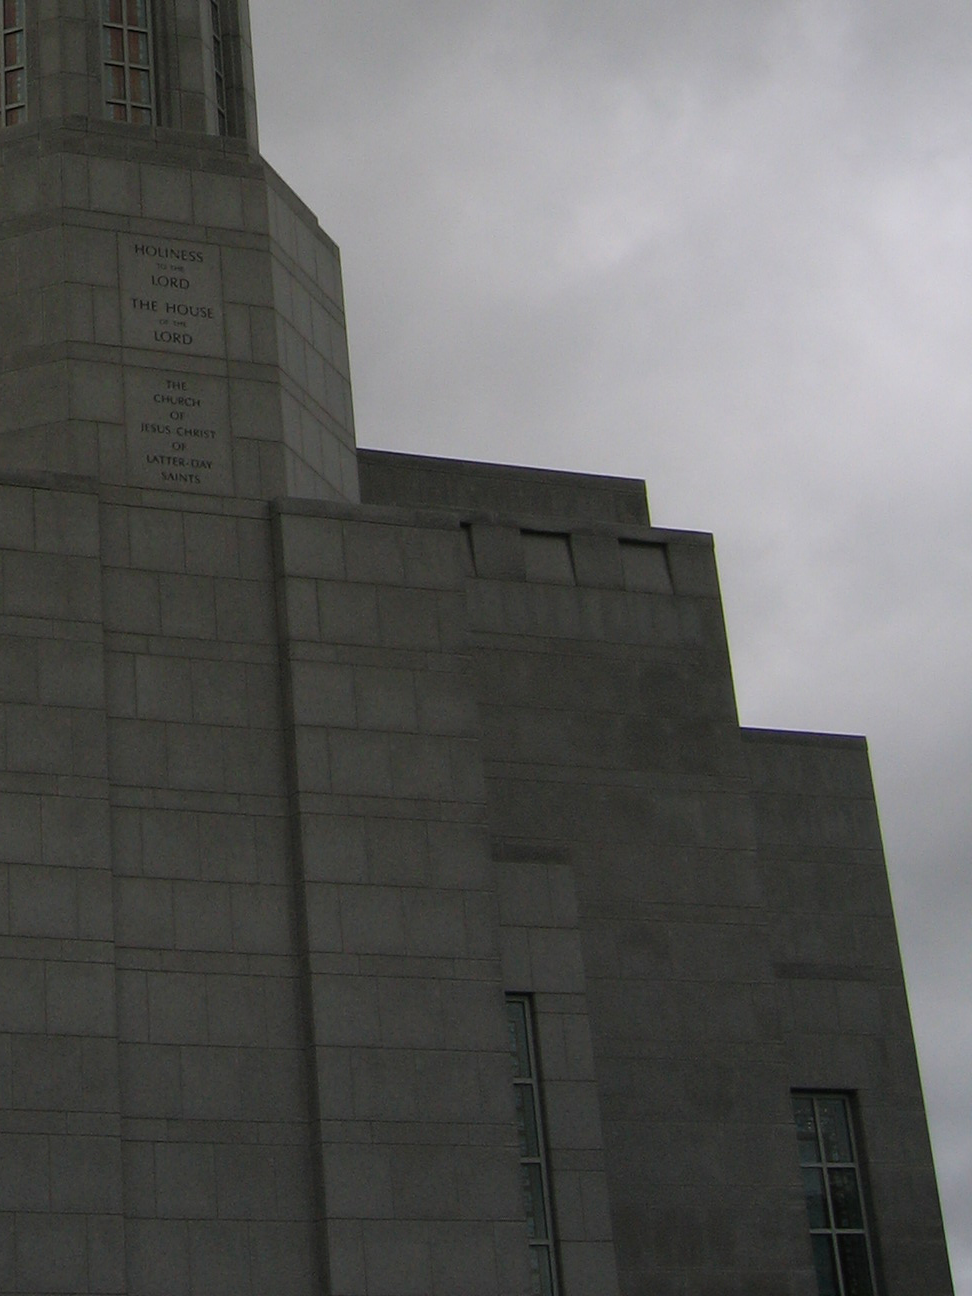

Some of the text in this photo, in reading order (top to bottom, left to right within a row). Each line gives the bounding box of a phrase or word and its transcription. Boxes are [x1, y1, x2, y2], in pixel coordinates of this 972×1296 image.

[134, 244, 203, 263] HOLINESS
[151, 275, 190, 290] LORD
[132, 298, 213, 319] THE HOUSE
[154, 331, 193, 345] LORD
[166, 380, 187, 391] THE
[154, 394, 201, 407] CHURCH
[170, 411, 184, 420] OF
[141, 423, 216, 439] JESUS CHRIST
[172, 442, 186, 451] OF
[147, 455, 213, 469] LATTER-DAY
[161, 471, 201, 484] SAINTS
